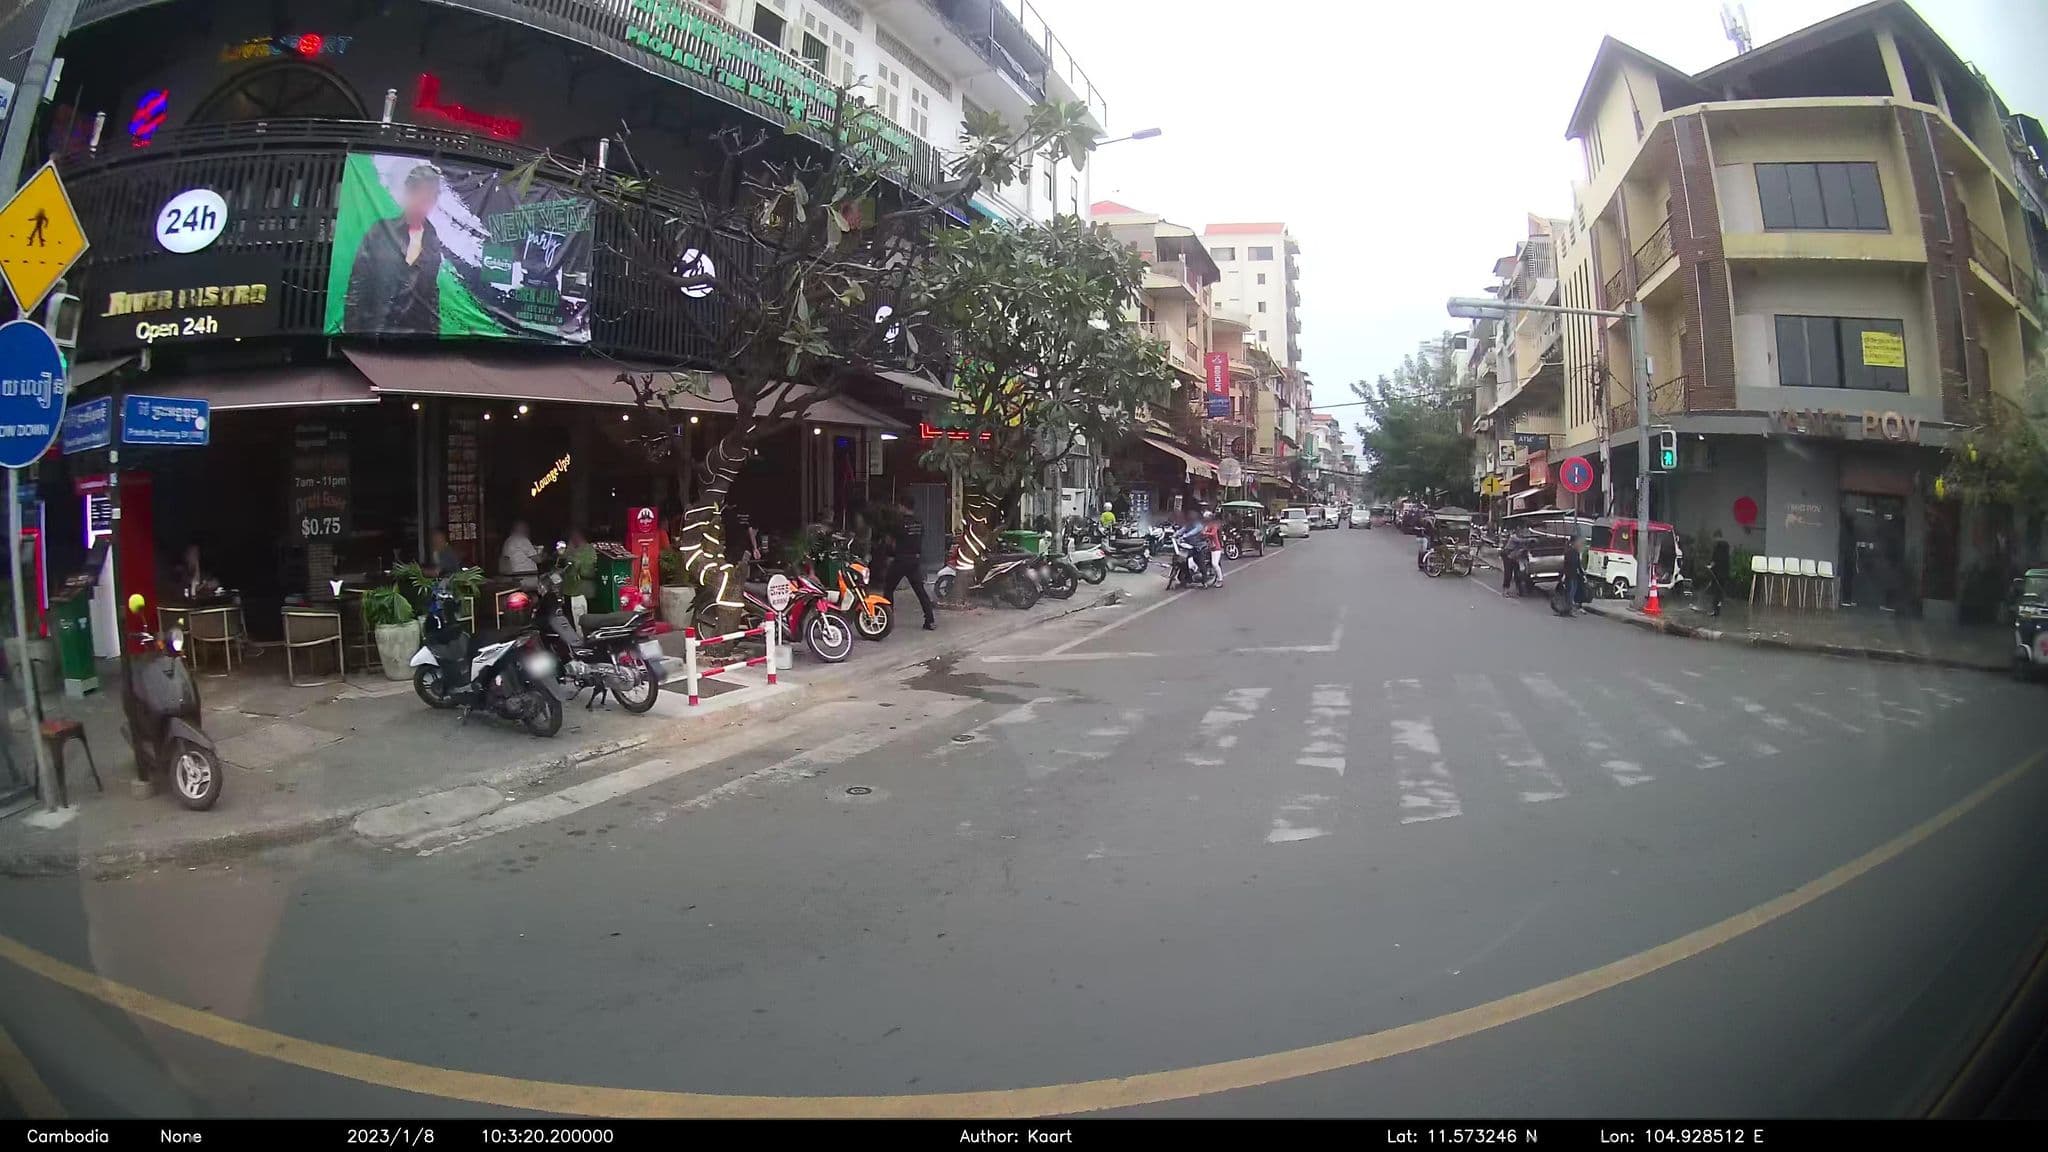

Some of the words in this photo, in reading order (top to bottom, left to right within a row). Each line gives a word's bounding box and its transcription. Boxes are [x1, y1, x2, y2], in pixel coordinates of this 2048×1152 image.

[625, 24, 712, 78] PROBABLY
[165, 205, 216, 235] 24h
[488, 210, 537, 243] NEW
[540, 204, 591, 233] YEAR
[523, 227, 566, 268] party
[136, 321, 179, 343] Open
[182, 315, 219, 335] 24h
[17, 423, 49, 437] DOWN
[295, 478, 314, 488] 7am
[323, 475, 347, 488] 11pm
[533, 467, 559, 493] Lounge
[301, 517, 341, 538] $0.75
